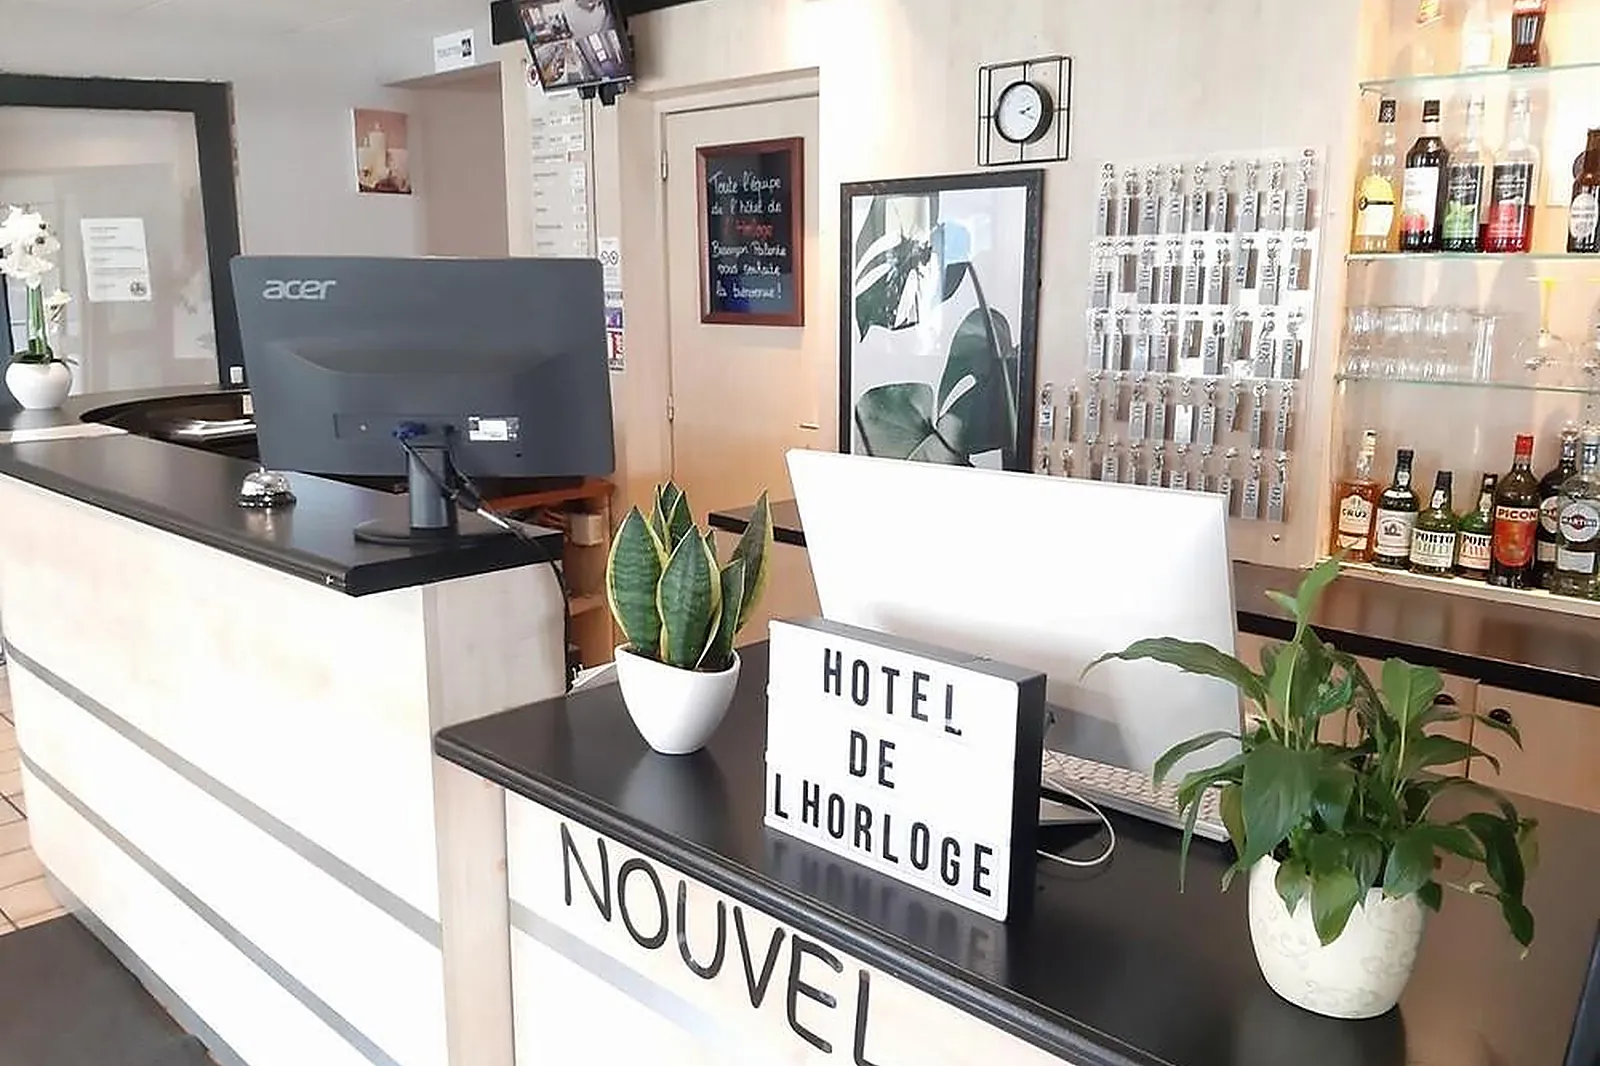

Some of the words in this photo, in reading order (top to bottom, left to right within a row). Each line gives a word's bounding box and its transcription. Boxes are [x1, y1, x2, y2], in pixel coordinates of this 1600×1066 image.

[262, 280, 336, 300] acer
[1498, 508, 1538, 519] PICON
[1415, 532, 1454, 544] PORTO
[823, 648, 962, 736] HOTEL
[849, 729, 896, 789] DE
